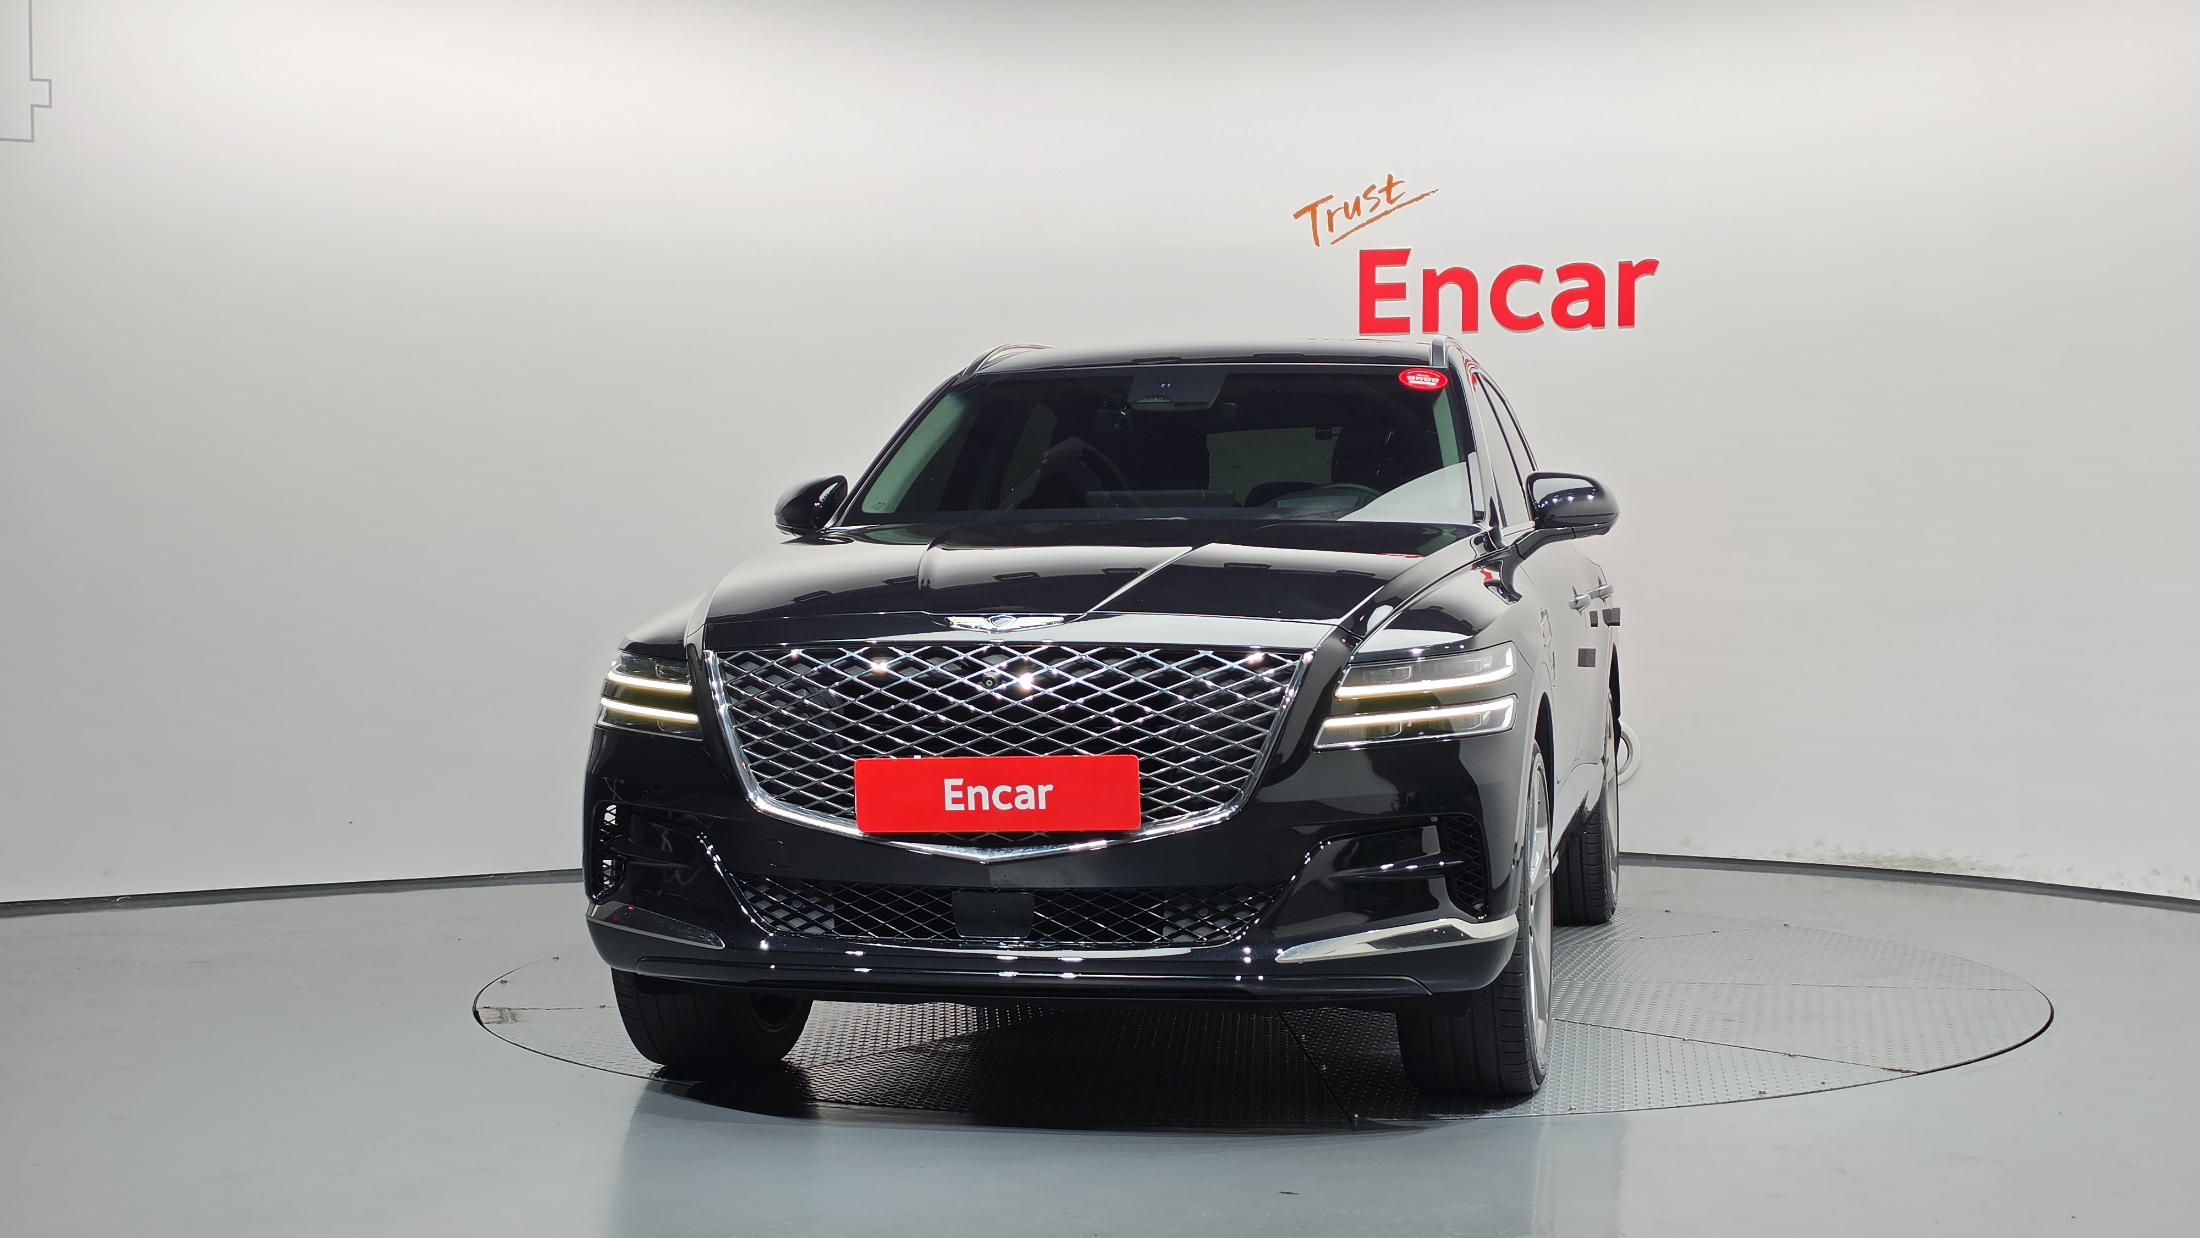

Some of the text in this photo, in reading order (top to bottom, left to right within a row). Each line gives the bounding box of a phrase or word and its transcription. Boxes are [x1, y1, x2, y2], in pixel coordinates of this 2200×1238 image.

[1293, 173, 1406, 247] Trust
[1358, 247, 1660, 335] Encar
[943, 778, 1054, 811] Encar
